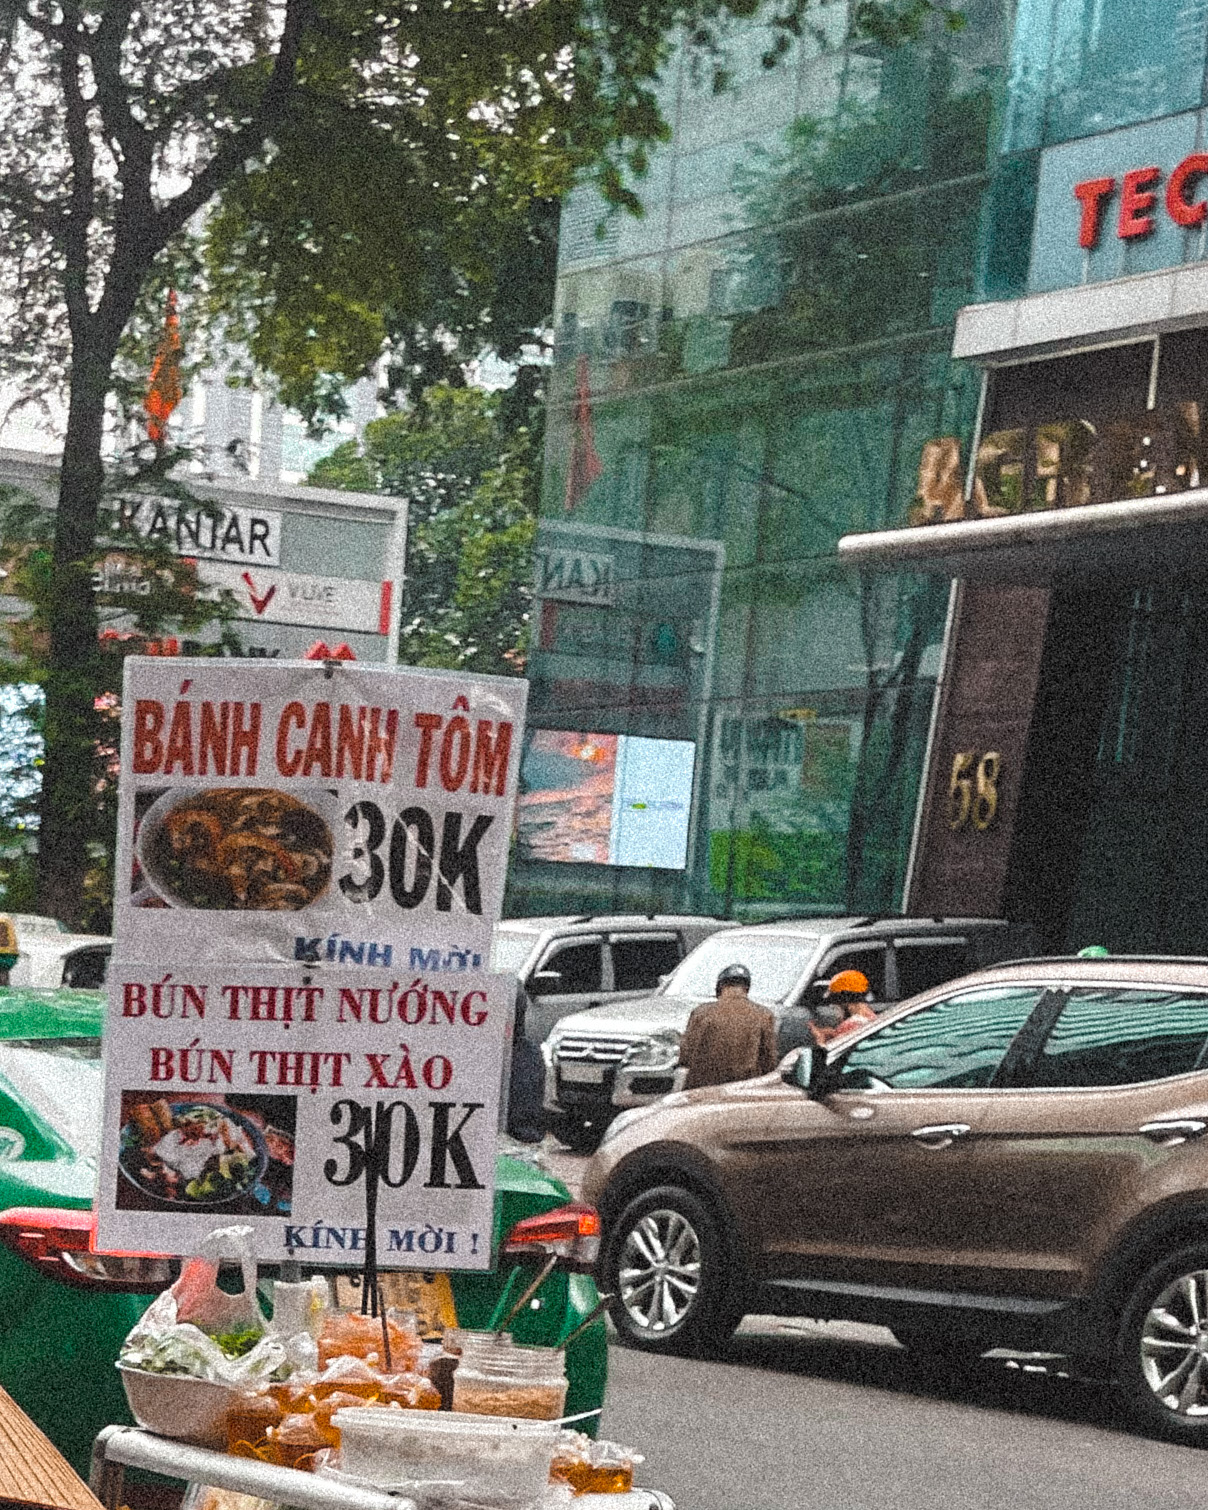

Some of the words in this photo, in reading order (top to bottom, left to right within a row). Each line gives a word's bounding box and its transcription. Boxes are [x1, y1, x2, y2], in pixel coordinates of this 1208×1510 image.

[1073, 153, 1208, 250] TEC
[130, 679, 263, 777] BÁNH
[275, 700, 400, 784] CANH
[413, 695, 514, 797] TÔM
[948, 750, 1001, 830] 58
[337, 800, 495, 917] 30K
[293, 933, 393, 968] KÍNH
[121, 974, 208, 1019] BÚN
[221, 984, 324, 1030] THỊT
[337, 978, 490, 1027] NƯỚNG
[149, 1039, 235, 1084] BÚN
[249, 1049, 352, 1095] THỊT
[363, 1043, 454, 1090] XÀO
[323, 1098, 486, 1191] 30K
[386, 1222, 457, 1254] MỜI
